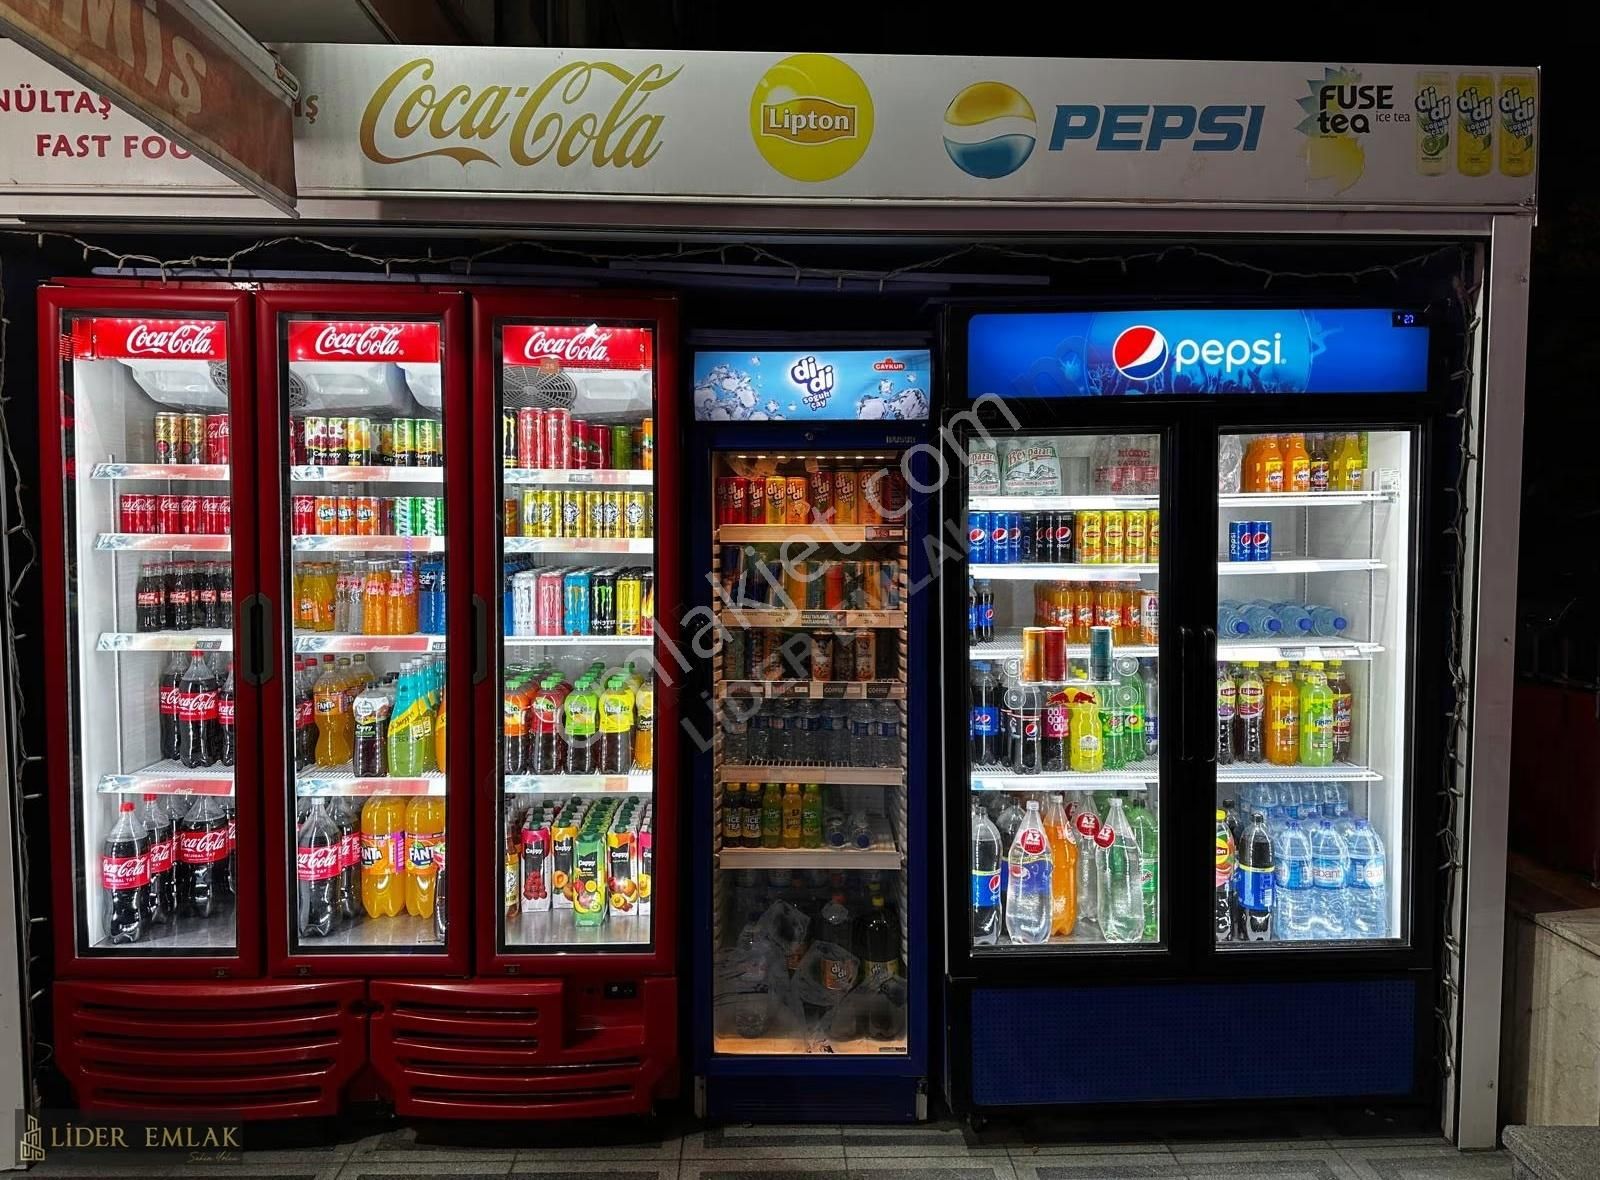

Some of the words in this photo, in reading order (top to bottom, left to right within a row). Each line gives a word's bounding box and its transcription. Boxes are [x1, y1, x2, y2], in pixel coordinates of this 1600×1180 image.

[1320, 85, 1394, 110] FUSE
[359, 58, 684, 168] Coca-Cola
[769, 109, 849, 135] Lipton
[1317, 111, 1370, 134] tea
[1375, 111, 1391, 123] ice
[1394, 112, 1411, 123] tea
[1048, 105, 1266, 152] PEPSI
[36, 134, 112, 157] FAST
[126, 324, 217, 355] Coca-Cola
[315, 325, 404, 356] Coca-Cola
[524, 328, 611, 361] Coca-Cola
[1176, 332, 1282, 373] pepsi
[791, 356, 817, 384] di
[807, 365, 834, 396] di
[1082, 817, 1095, 825] AZ
[1027, 833, 1040, 841] AZ
